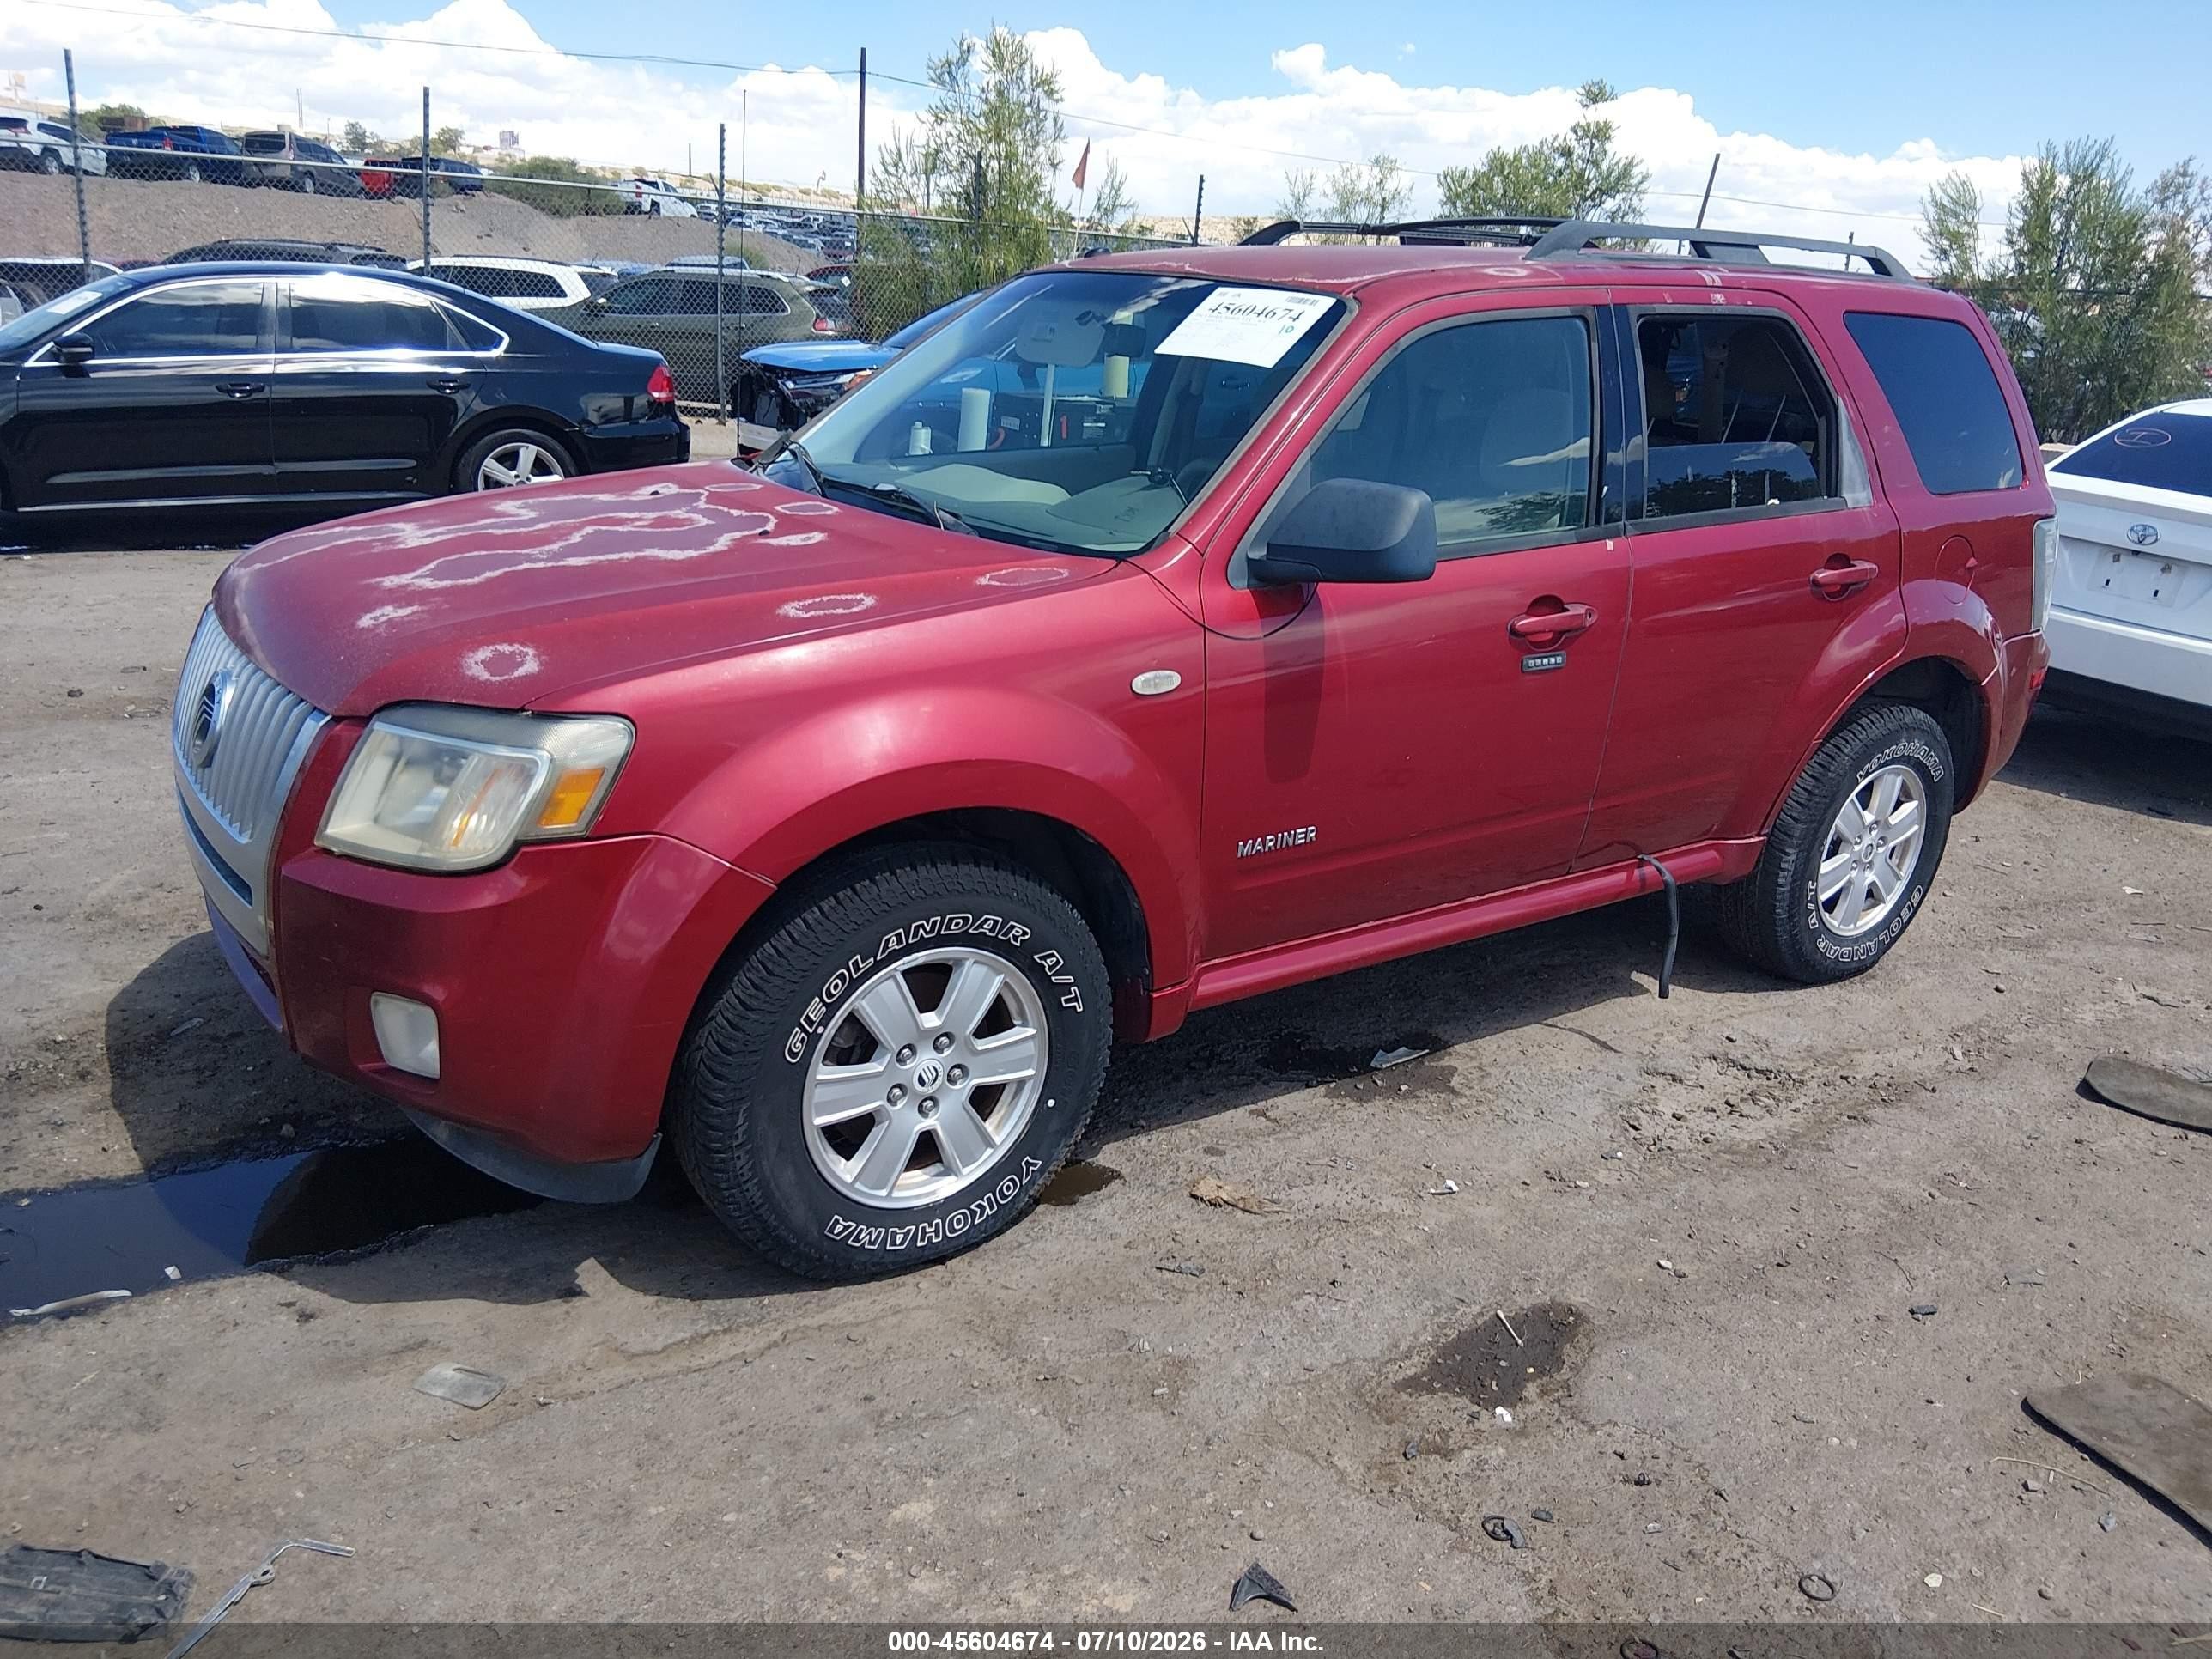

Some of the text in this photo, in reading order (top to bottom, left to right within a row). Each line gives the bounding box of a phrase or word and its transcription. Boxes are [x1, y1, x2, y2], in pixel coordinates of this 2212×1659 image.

[1209, 302, 1305, 322] 45604674
[1856, 741, 1945, 783] YOKOHAMA
[1237, 825, 1318, 859] MARINER
[1816, 884, 1923, 963] GEOLANDAR
[784, 913, 1084, 1064] GEOLANDAR A/T
[823, 1155, 1042, 1250] YOKOHAMA
